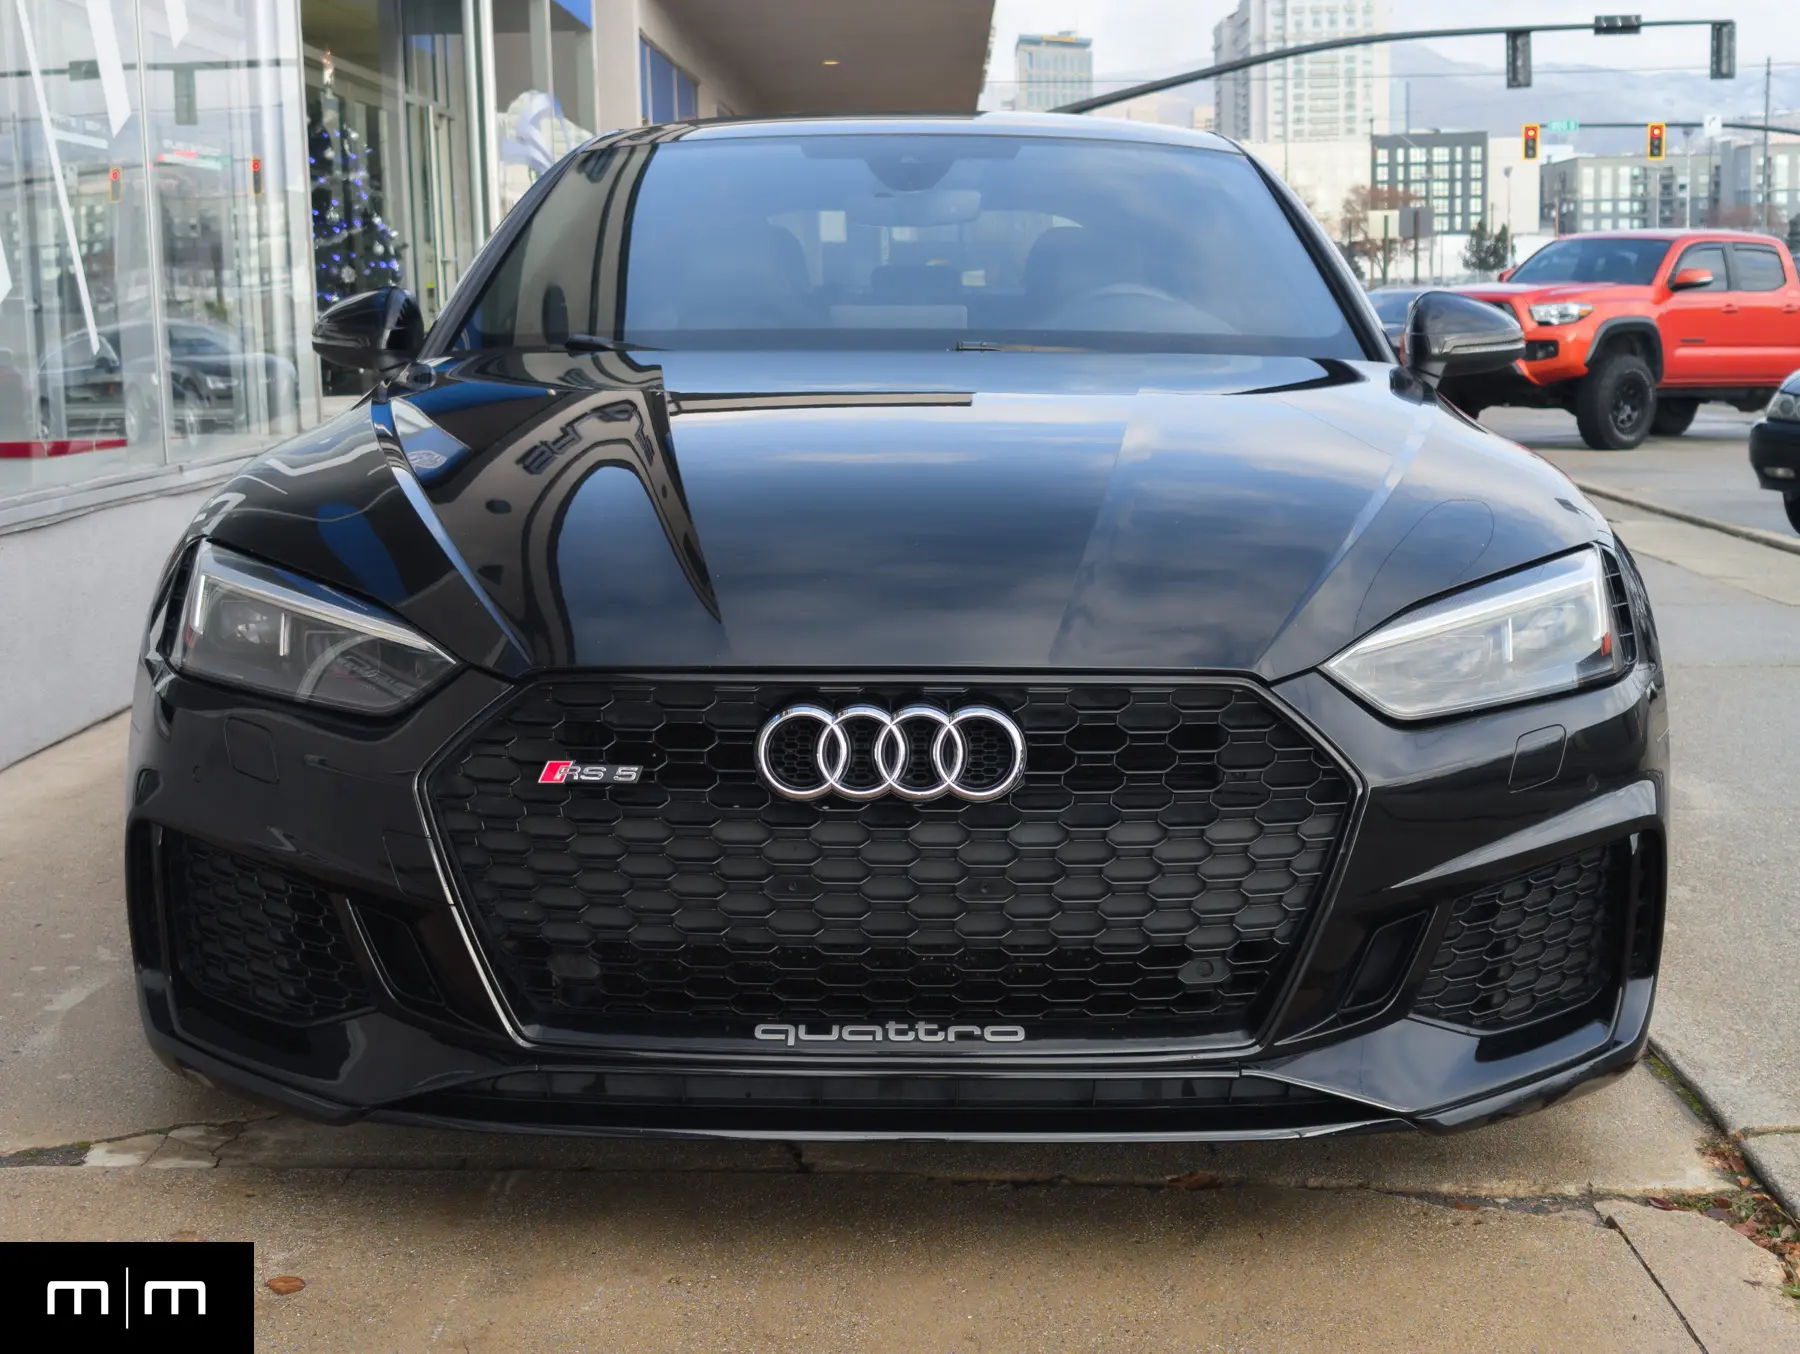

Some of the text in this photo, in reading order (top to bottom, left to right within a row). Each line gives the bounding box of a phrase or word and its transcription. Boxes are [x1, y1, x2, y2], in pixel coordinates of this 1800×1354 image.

[553, 765, 639, 782] RS 5
[754, 1020, 1026, 1046] quattro
